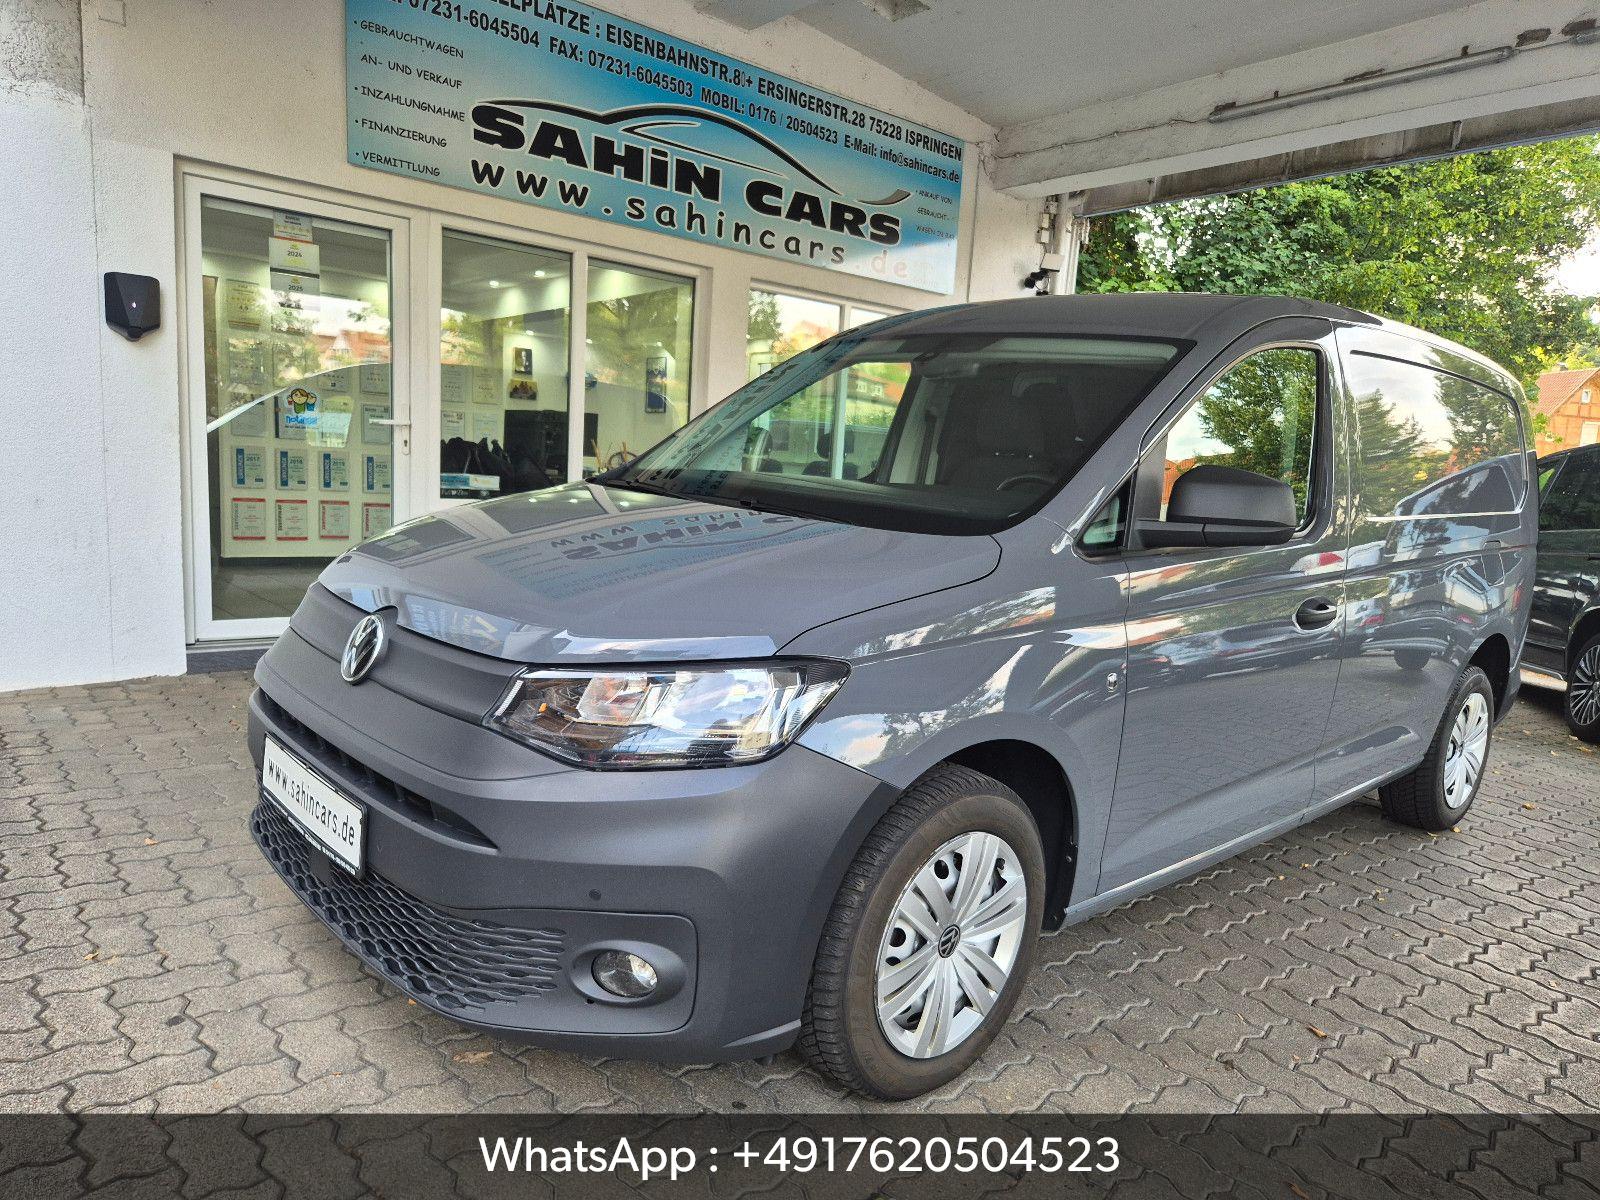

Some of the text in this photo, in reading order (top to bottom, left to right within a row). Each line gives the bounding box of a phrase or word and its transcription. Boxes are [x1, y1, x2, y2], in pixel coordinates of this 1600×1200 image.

[360, 20, 464, 59] GEBRAUCHTWAGEN
[360, 53, 463, 91] AN- UND VERKAUF
[490, 0, 590, 35] LPLÄTZE
[757, 77, 866, 129] ERSINGERSTR.28
[868, 116, 902, 141] 75228
[905, 128, 962, 162] ISPRINGEN
[360, 85, 466, 123] INZAHLUNGNAHME
[549, 36, 584, 63] FAX:
[588, 50, 693, 98] 07231-6045503
[700, 86, 745, 115] MOBIL:
[748, 103, 777, 125] 0176
[785, 115, 838, 145] 20504523
[844, 134, 877, 158] E-Mail:
[879, 146, 960, 184] info@sahincars.de
[361, 118, 448, 149] FINANZIERUNG
[362, 150, 441, 177] VERMITTLUNG
[745, 180, 900, 246] CARS
[268, 758, 356, 847] www.sahincars.de
